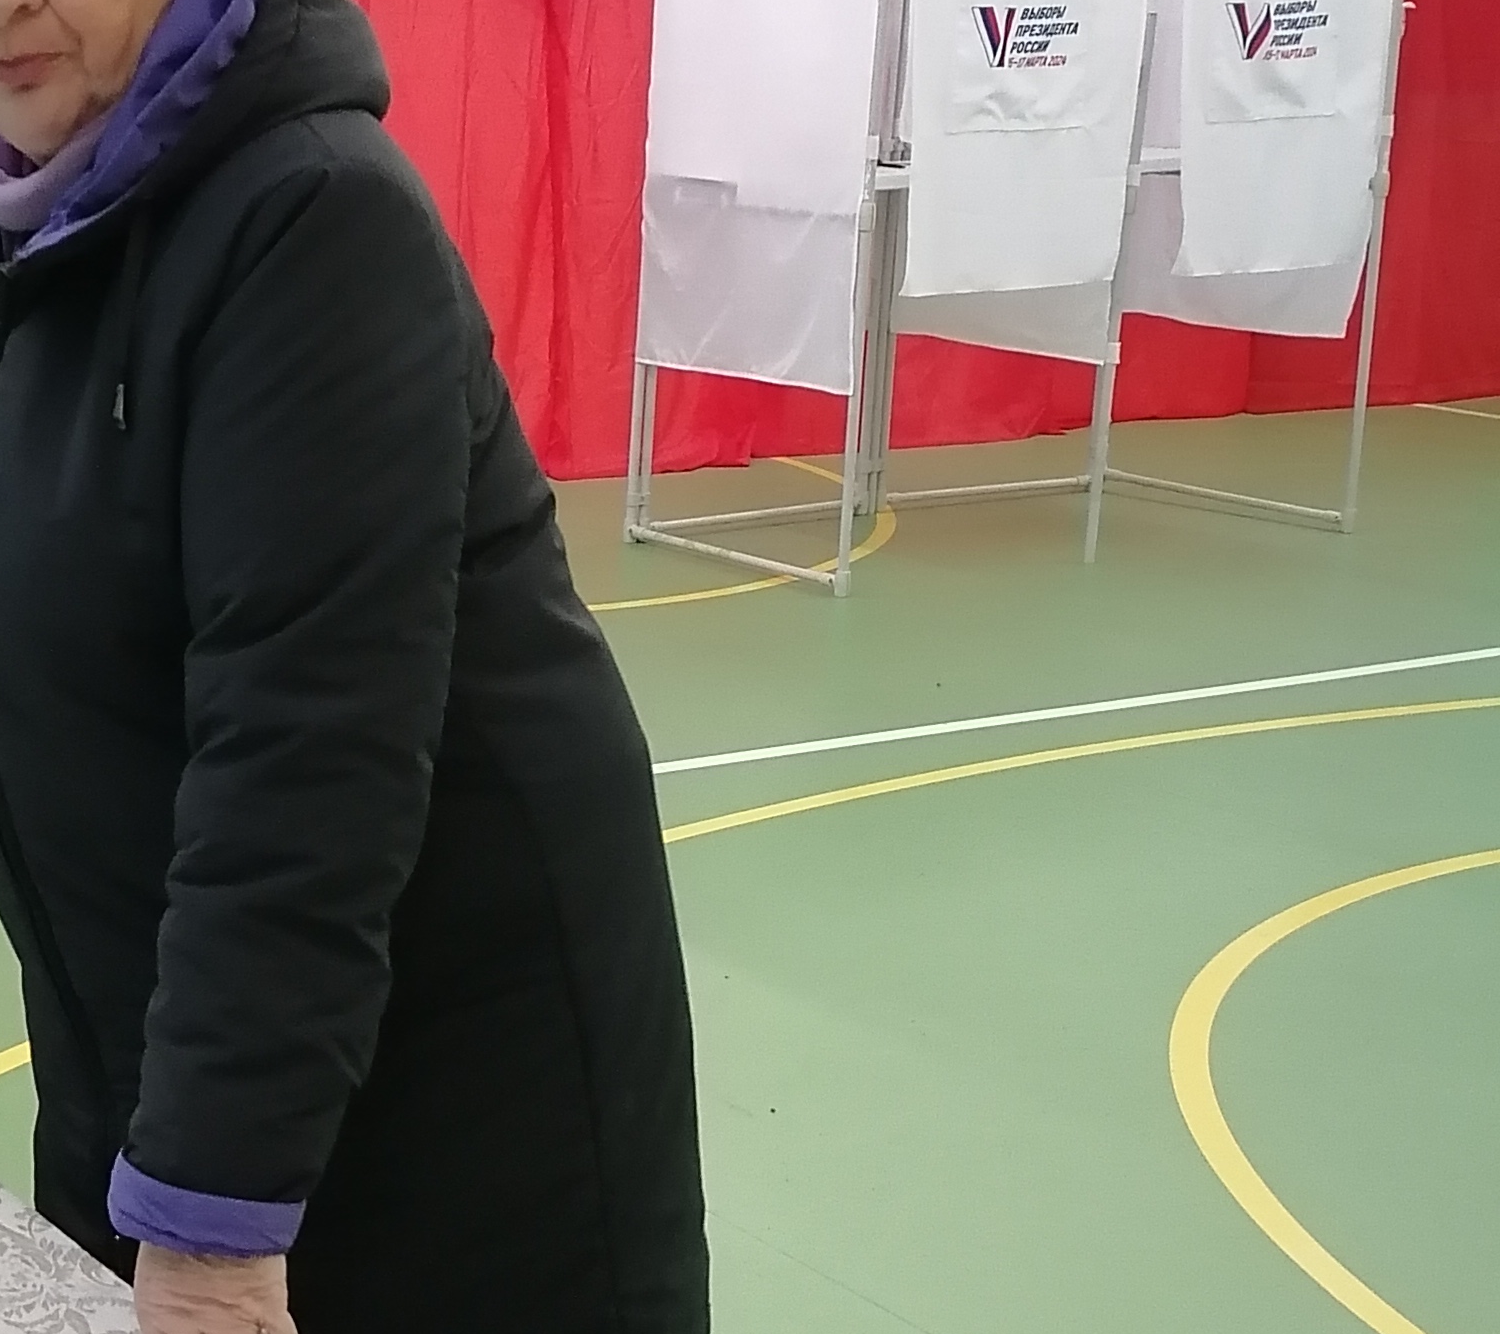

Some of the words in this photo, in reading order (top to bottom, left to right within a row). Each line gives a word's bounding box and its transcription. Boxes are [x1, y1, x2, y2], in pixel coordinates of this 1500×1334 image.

[1020, 5, 1067, 20] ВЫБОРЫ
[1273, 0, 1317, 16] ВЫБОРЫ
[1015, 21, 1079, 37] ПРЕЗИДЕНТА
[1010, 39, 1051, 54] РОССИИ
